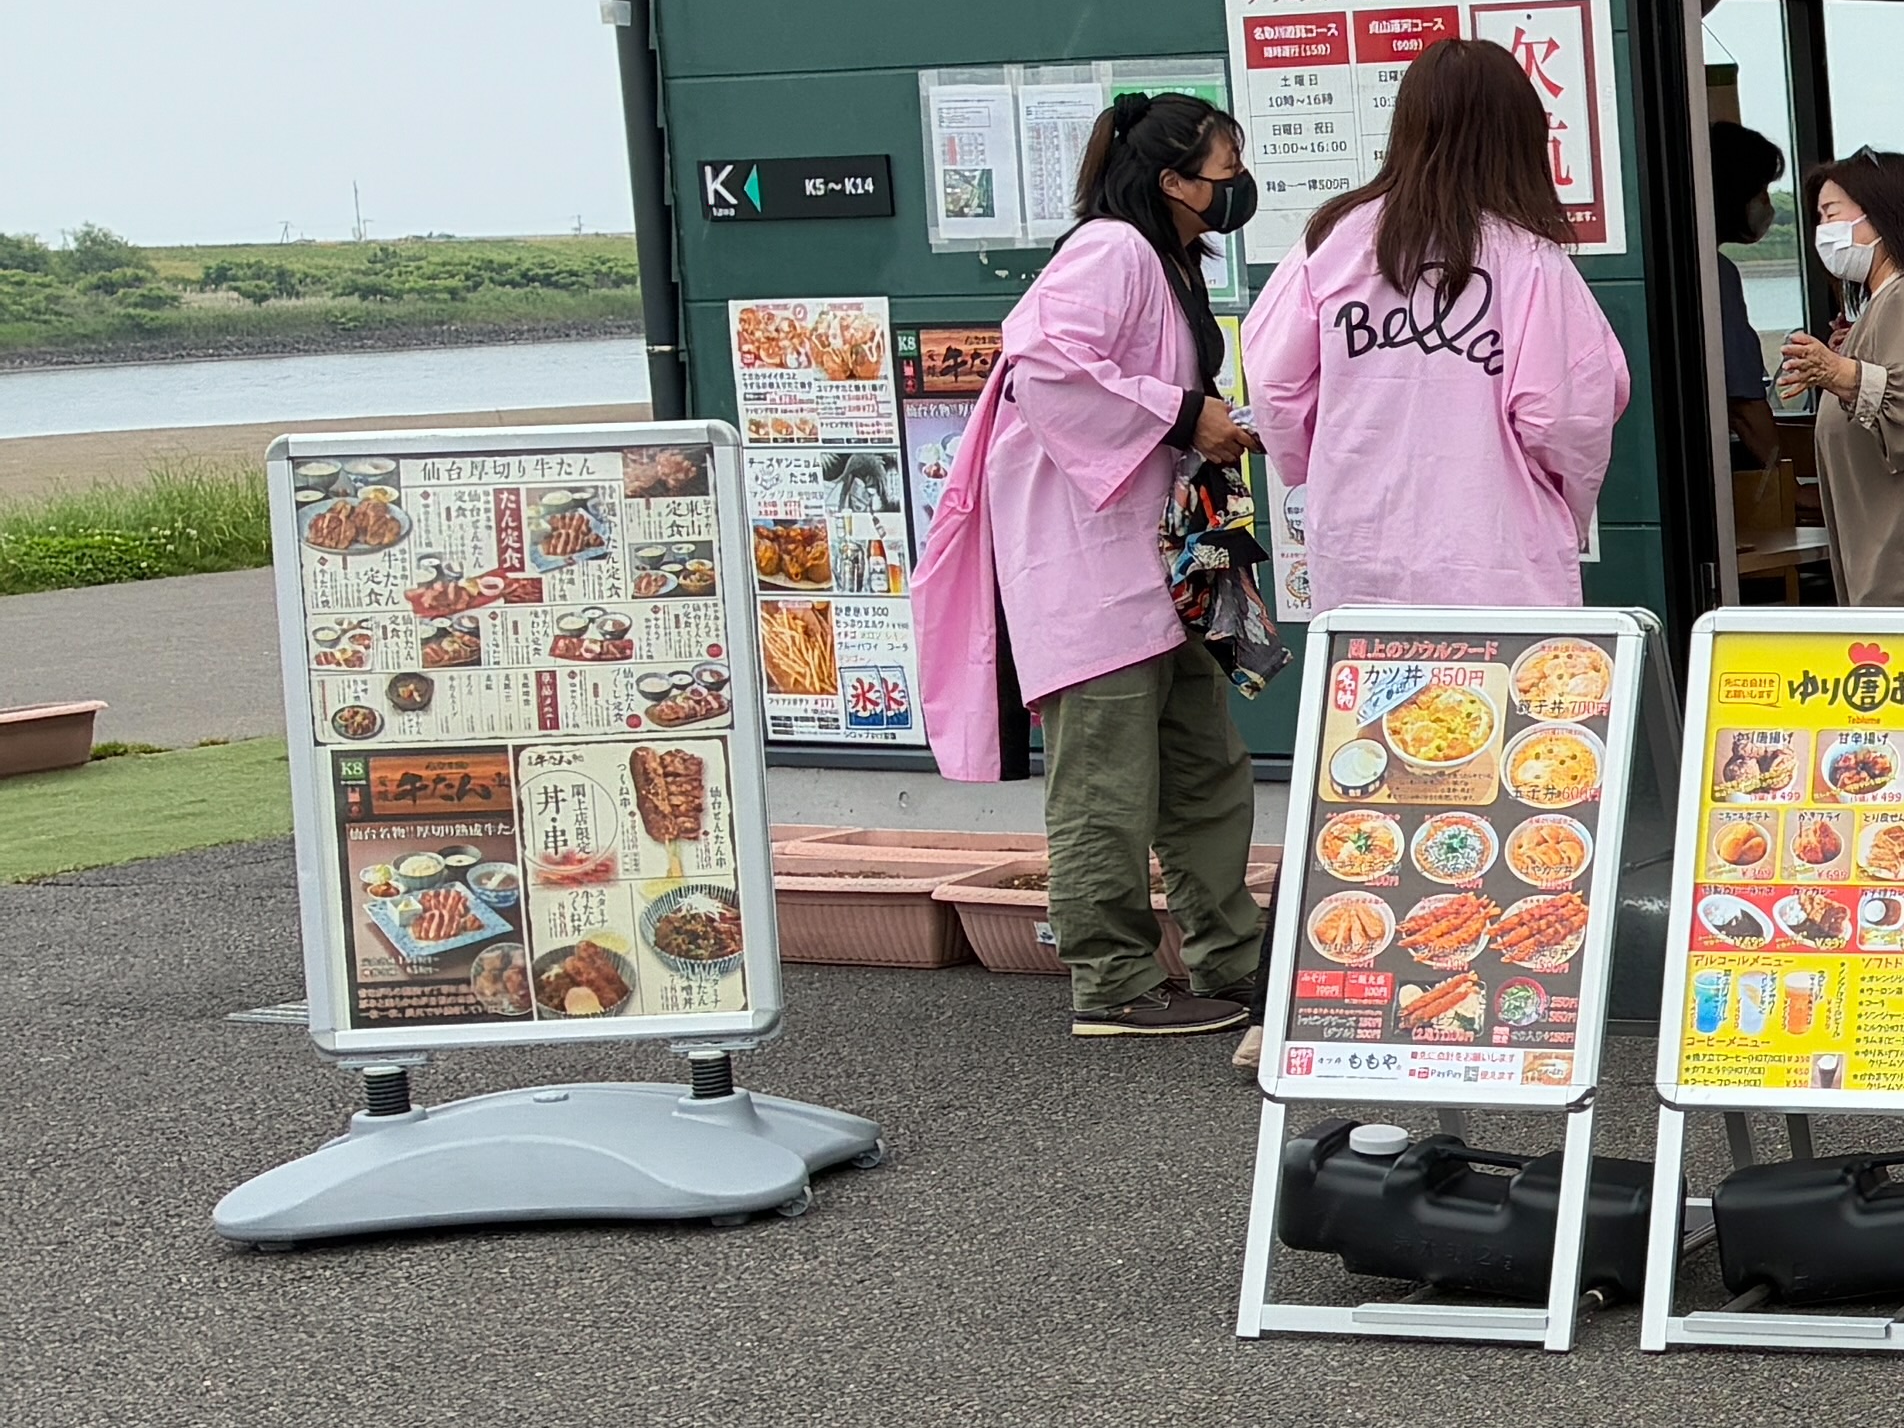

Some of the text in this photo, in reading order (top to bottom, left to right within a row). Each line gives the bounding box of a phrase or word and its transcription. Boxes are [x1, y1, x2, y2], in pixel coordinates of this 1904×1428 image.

[704, 165, 738, 205] K
[500, 491, 521, 568] たん定食
